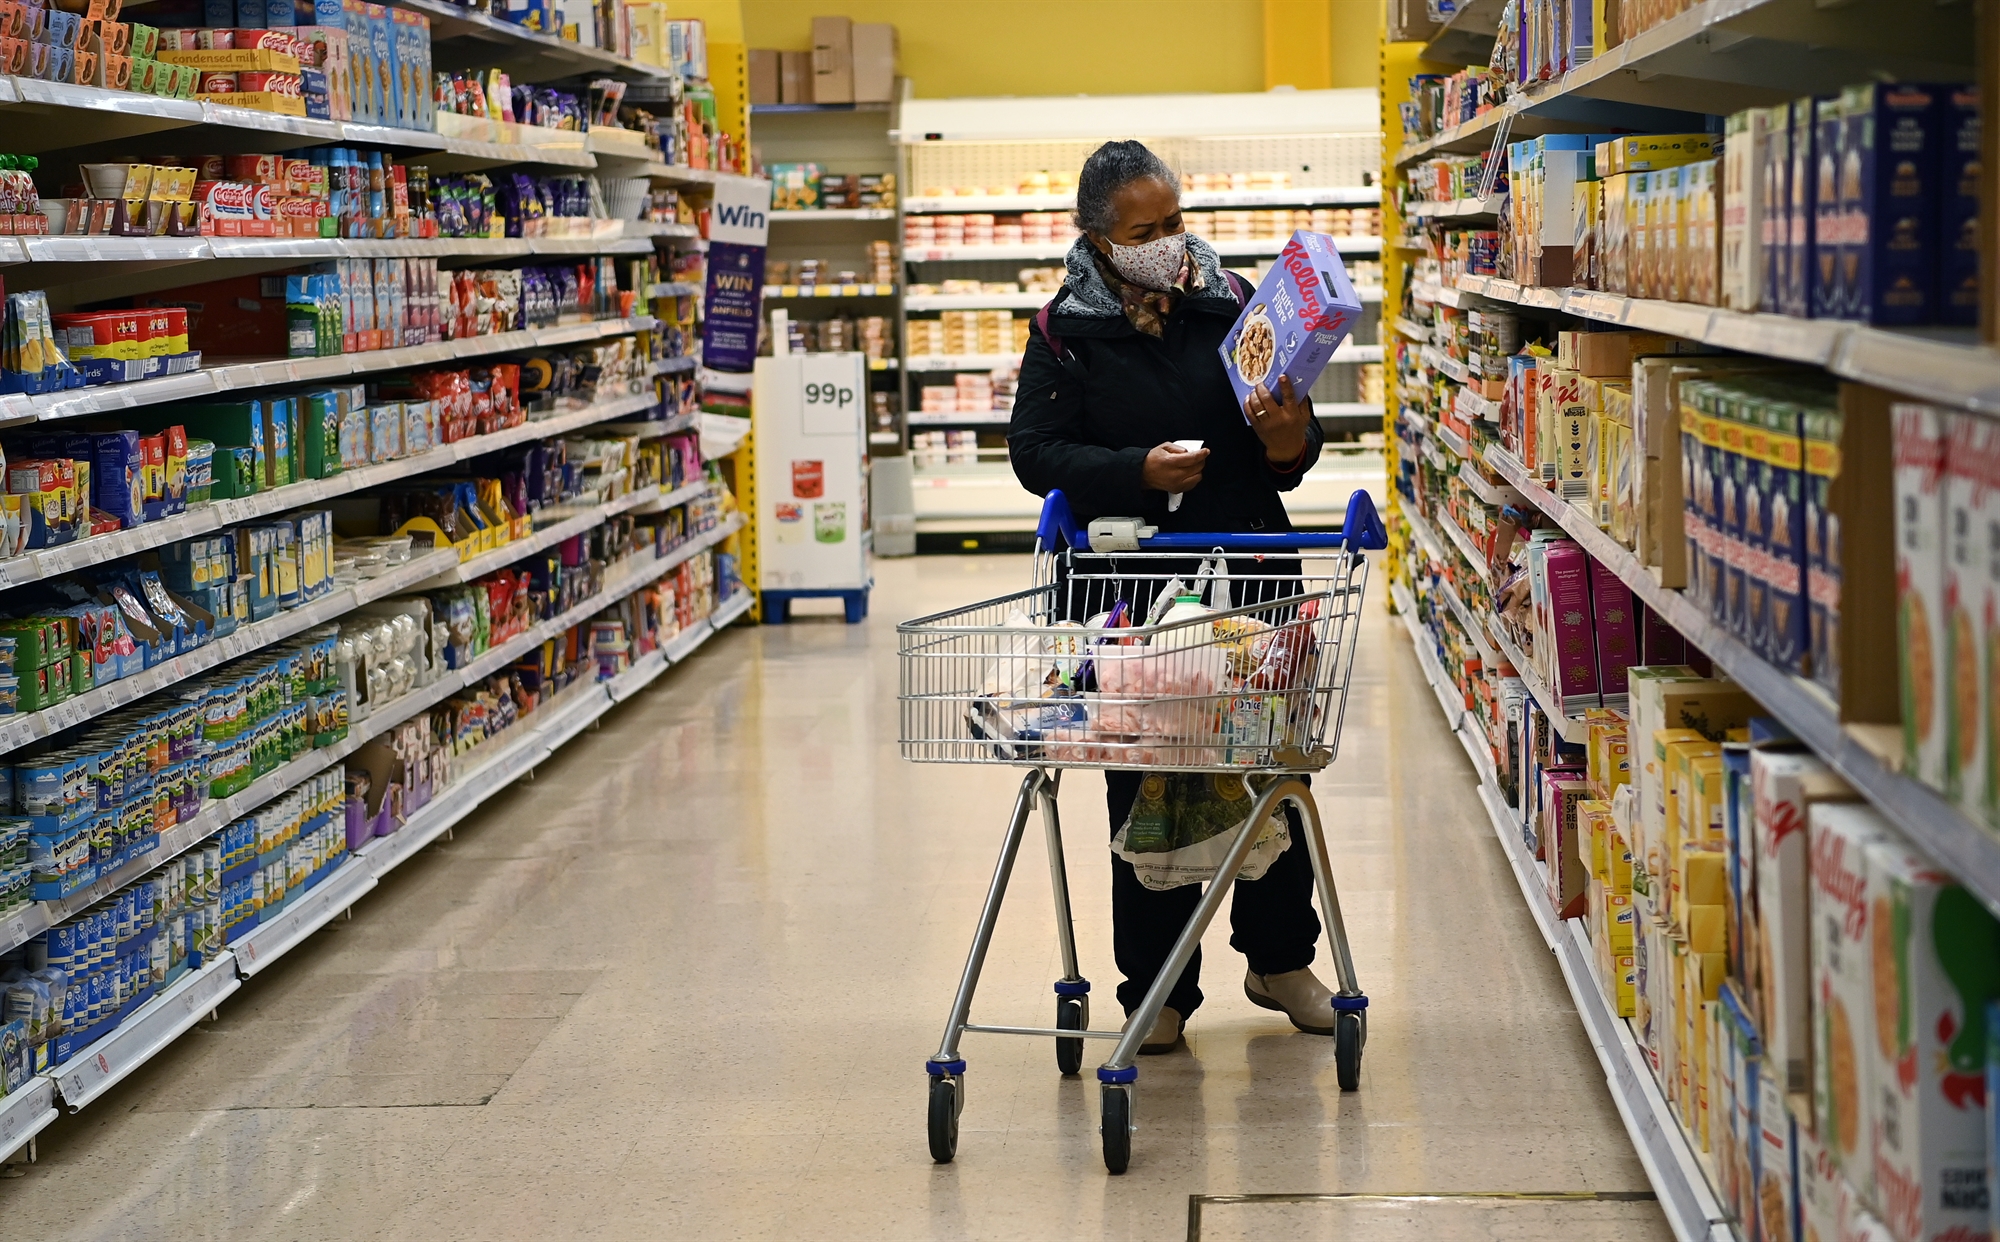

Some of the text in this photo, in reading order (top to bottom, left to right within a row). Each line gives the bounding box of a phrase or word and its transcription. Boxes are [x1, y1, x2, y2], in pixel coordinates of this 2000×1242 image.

[172, 49, 260, 64] condensed milk
[239, 96, 261, 105] milk
[717, 203, 765, 229] Win
[715, 273, 754, 292] WIN
[1282, 240, 1347, 332] Kellogg's
[1275, 277, 1295, 321] Fruit'n
[712, 305, 753, 317] ANFIELD
[1271, 296, 1287, 326] Fibre
[1314, 331, 1338, 341] Fruit'n
[1315, 337, 1333, 346] Fibre
[805, 383, 853, 408] 99p
[1563, 408, 1586, 417] Wheats
[1538, 749, 1548, 757] 16
[1623, 958, 1633, 966] 48
[58, 1041, 70, 1053] TESCO
